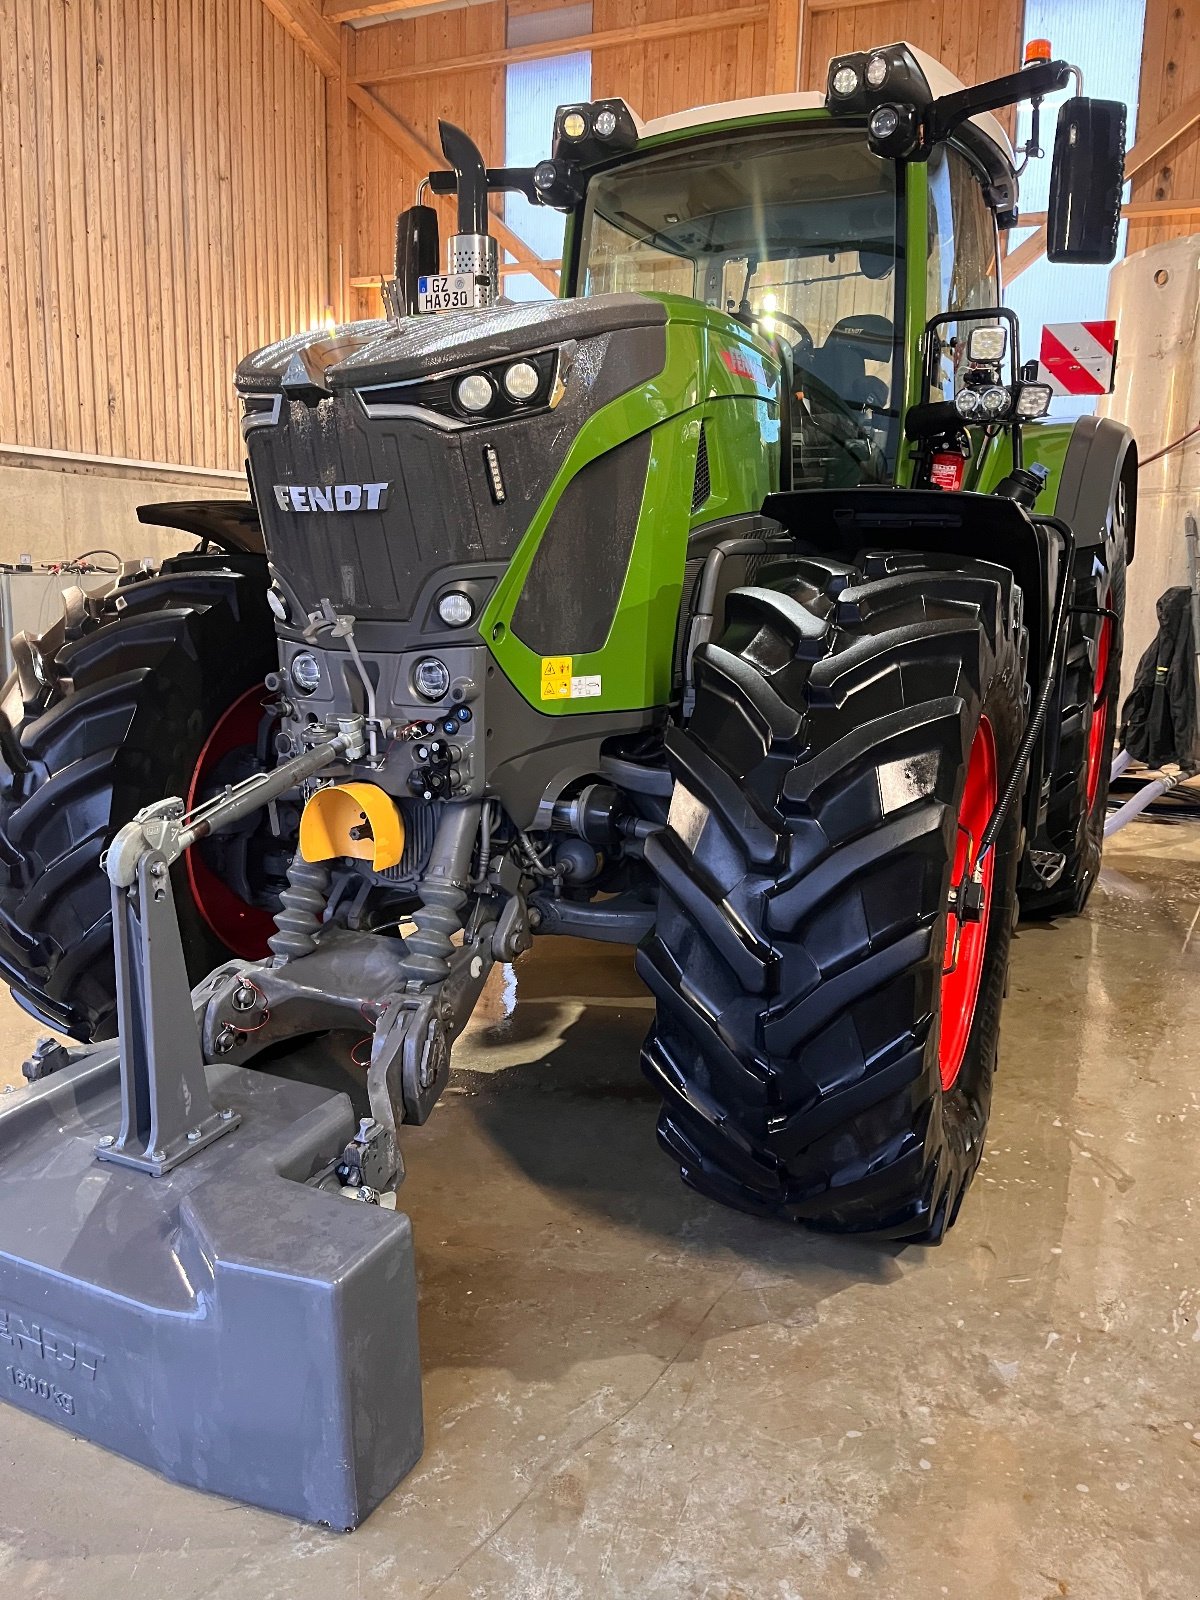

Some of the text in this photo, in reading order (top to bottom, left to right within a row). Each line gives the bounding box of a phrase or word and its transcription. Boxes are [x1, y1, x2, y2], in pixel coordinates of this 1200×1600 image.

[432, 277, 449, 293] GZ
[425, 291, 468, 309] HA930
[273, 482, 389, 511] FENDT
[0, 1311, 106, 1381] ENDT
